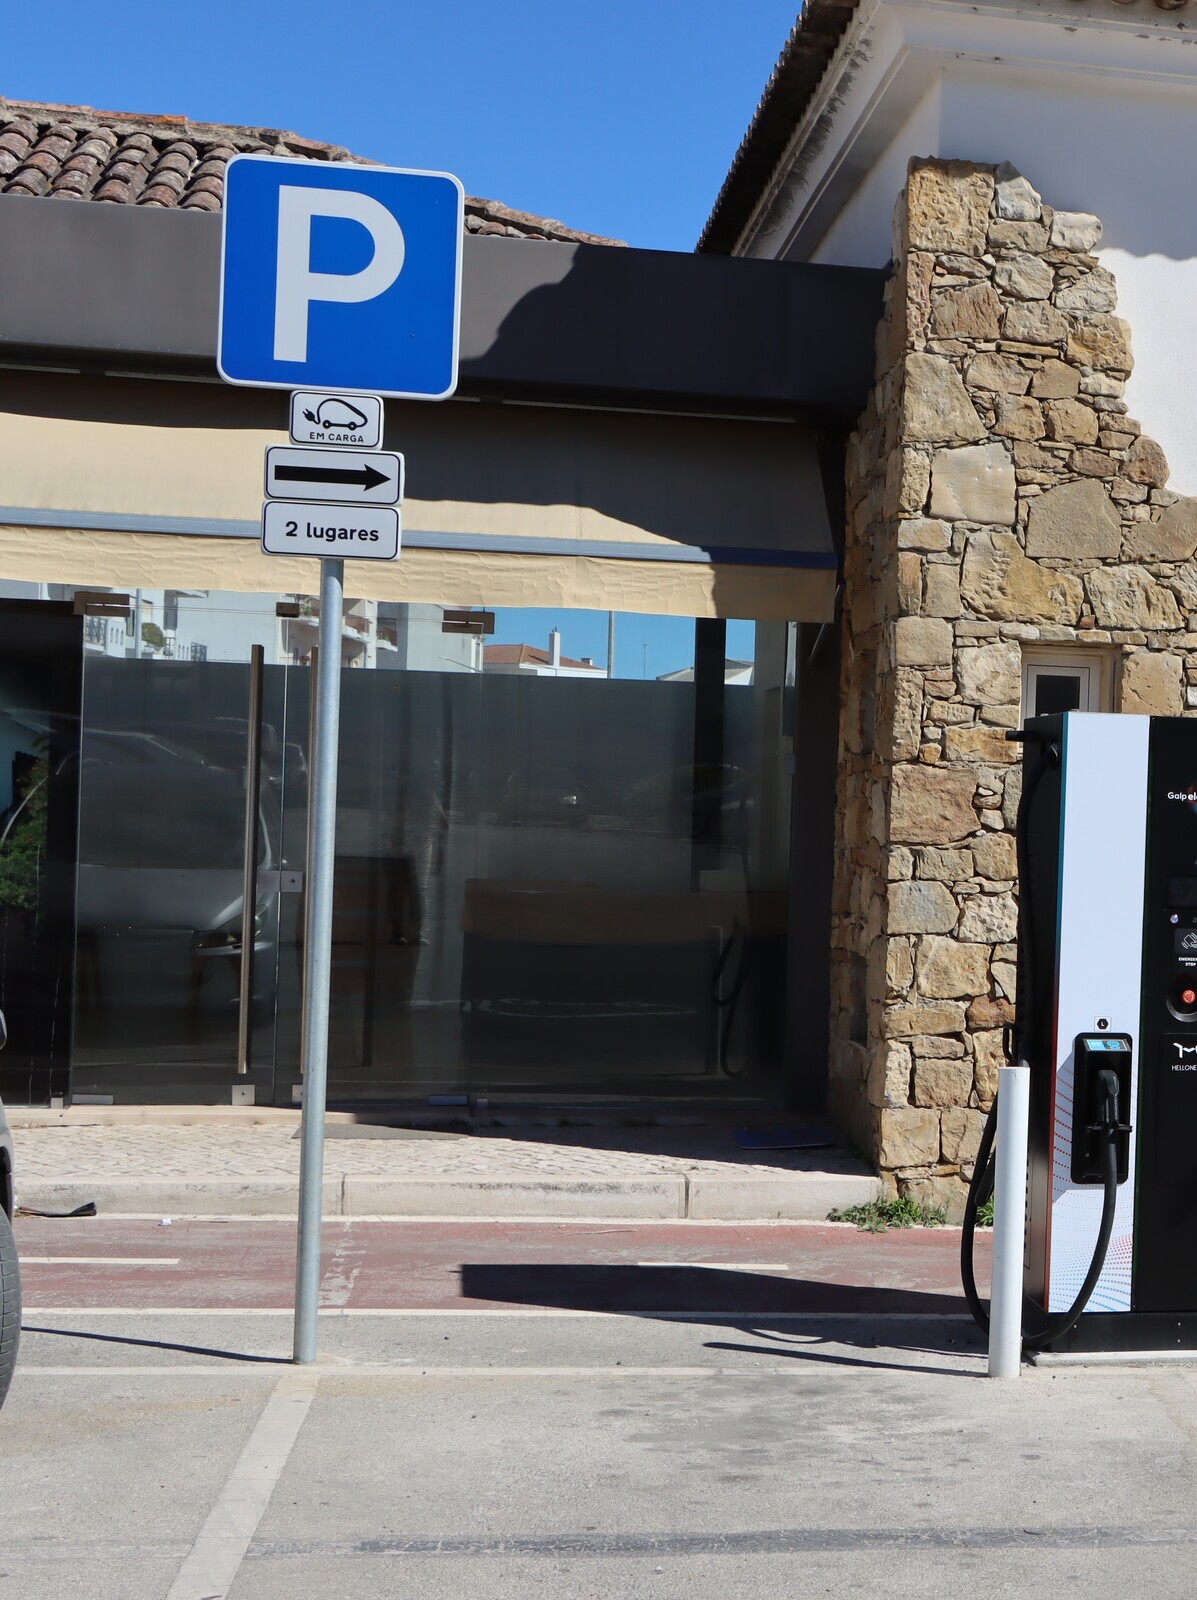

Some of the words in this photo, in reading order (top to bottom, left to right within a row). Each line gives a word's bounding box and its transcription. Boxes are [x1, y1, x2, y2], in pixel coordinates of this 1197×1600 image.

[274, 184, 406, 363] P
[309, 431, 325, 442] EM
[328, 432, 365, 444] CARGA
[285, 520, 298, 537] 2
[306, 521, 380, 545] lugares
[1167, 791, 1187, 801] Galp
